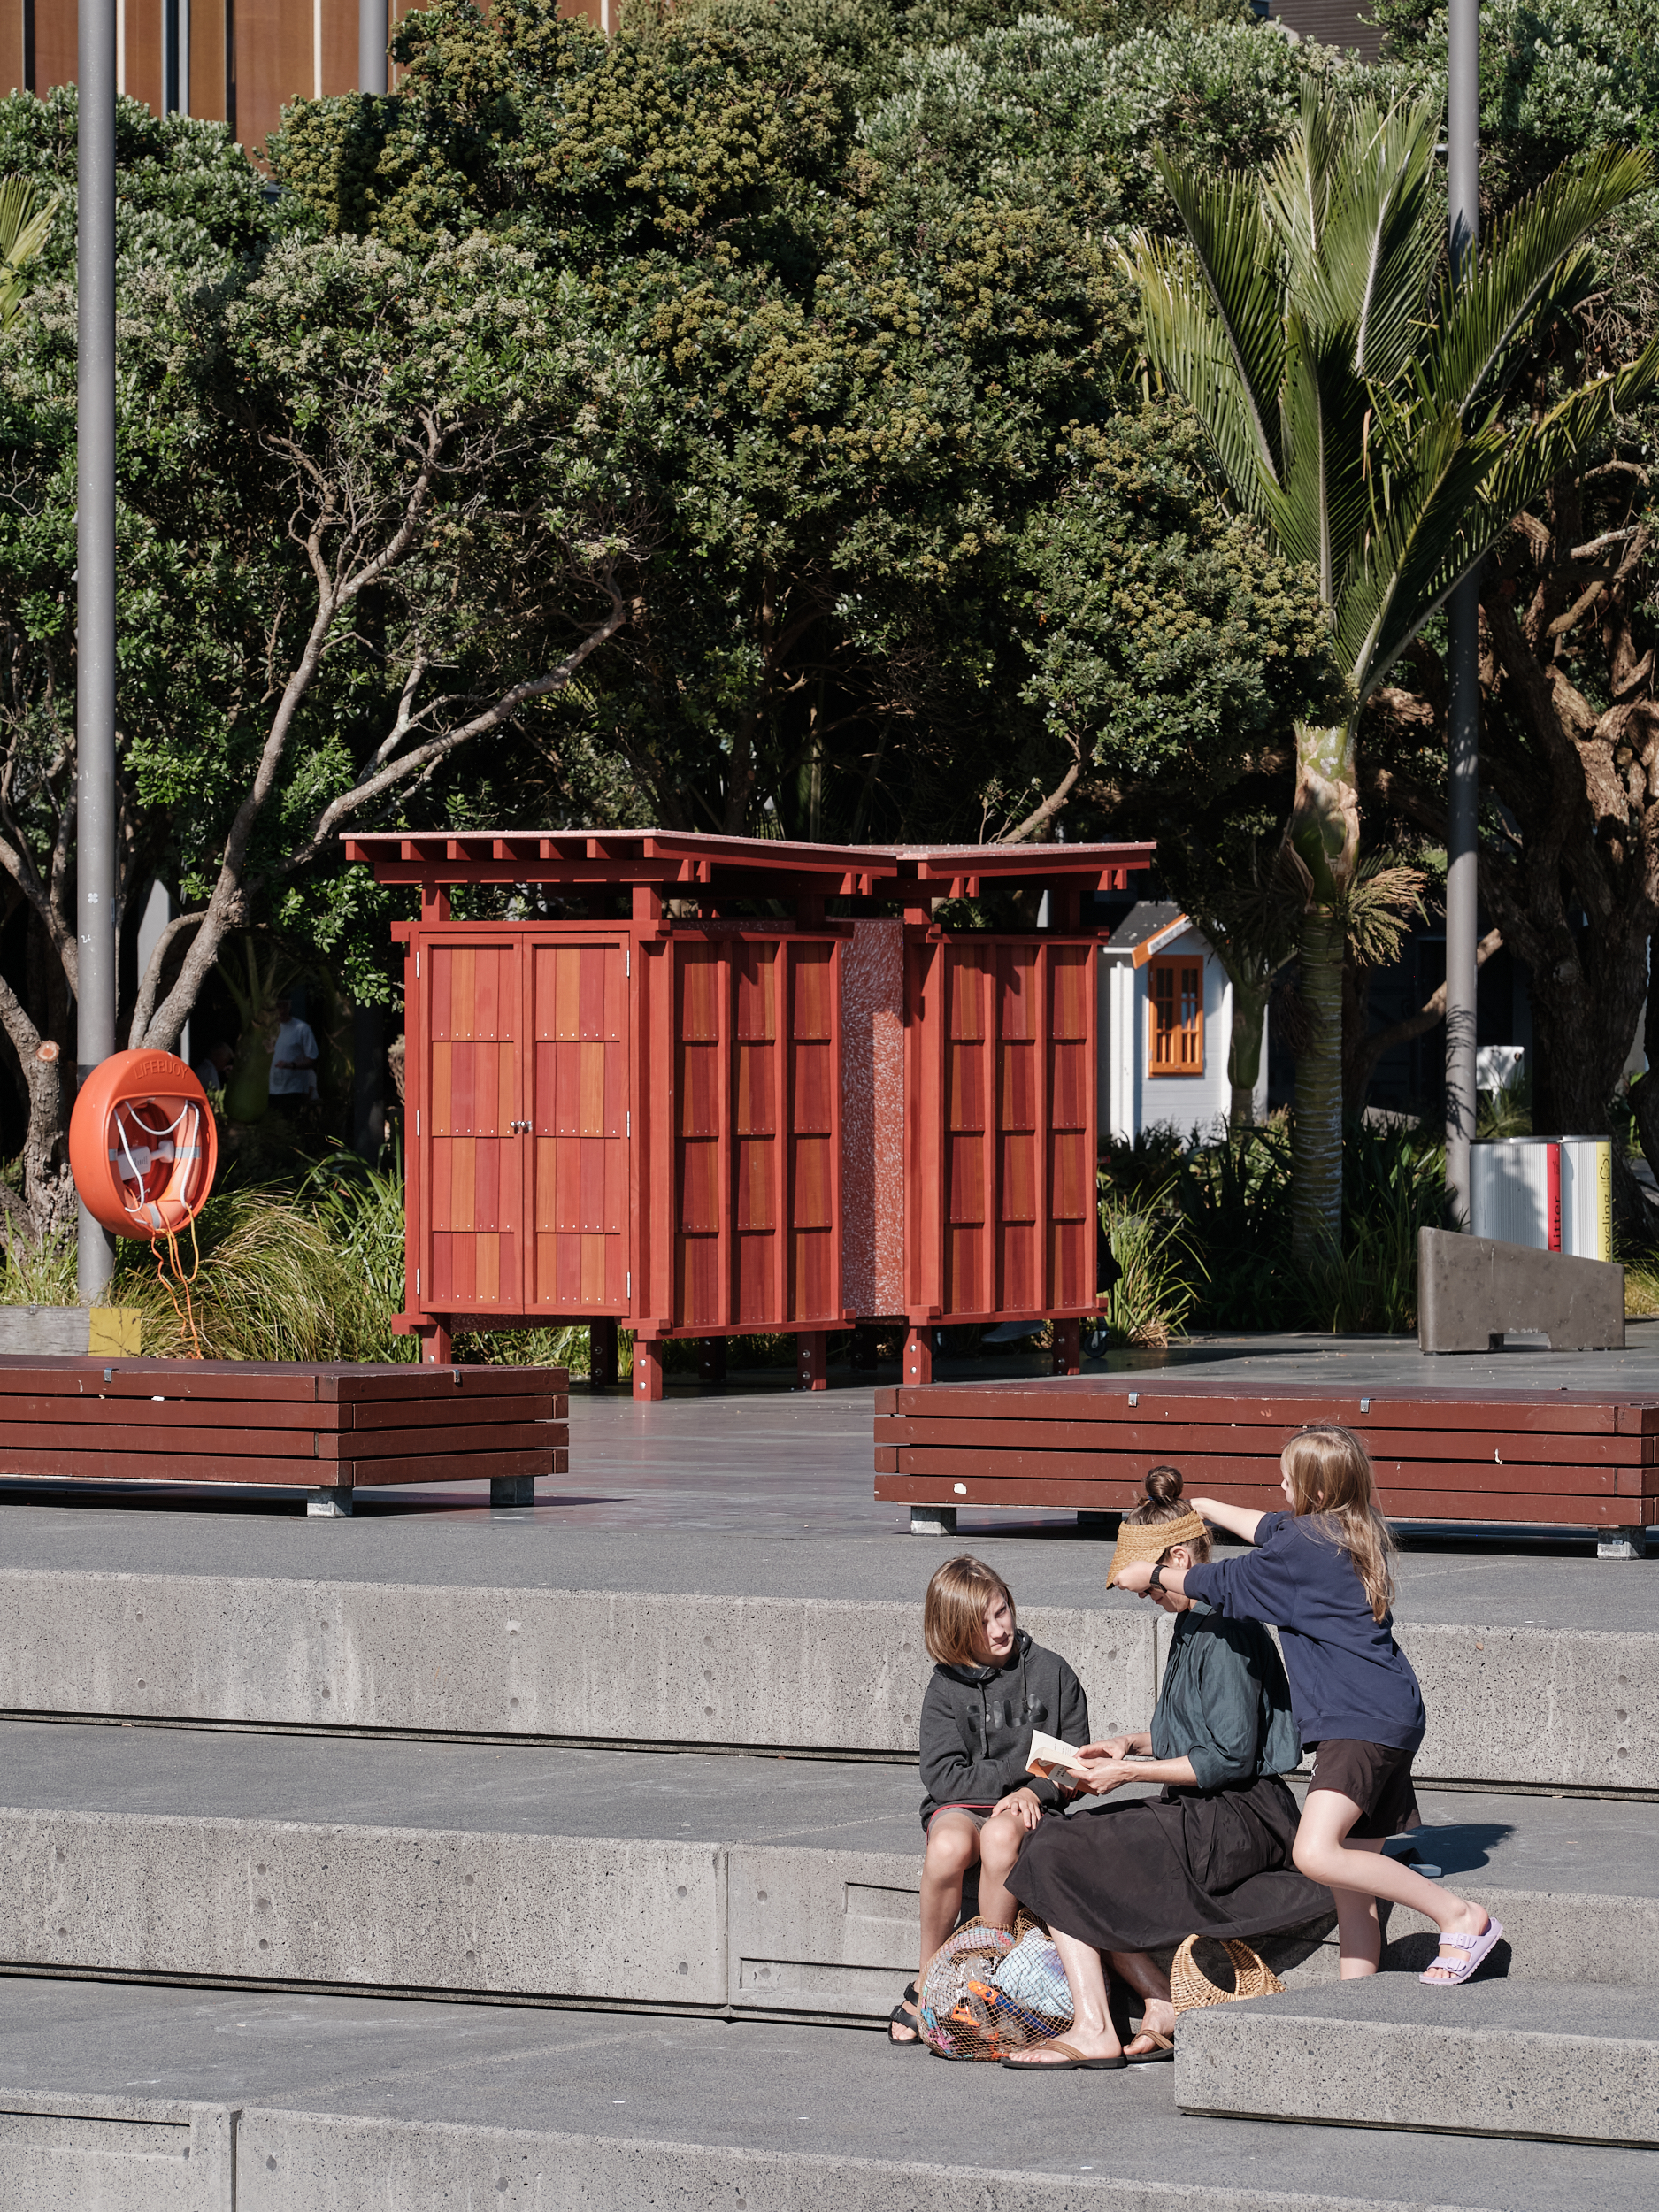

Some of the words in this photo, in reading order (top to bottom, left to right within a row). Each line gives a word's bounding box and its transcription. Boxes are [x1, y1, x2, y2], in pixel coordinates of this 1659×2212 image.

[133, 1059, 188, 1079] LIFEBUOY
[1602, 1194, 1611, 1263] ecycling
[966, 1694, 1048, 1732] FILA
